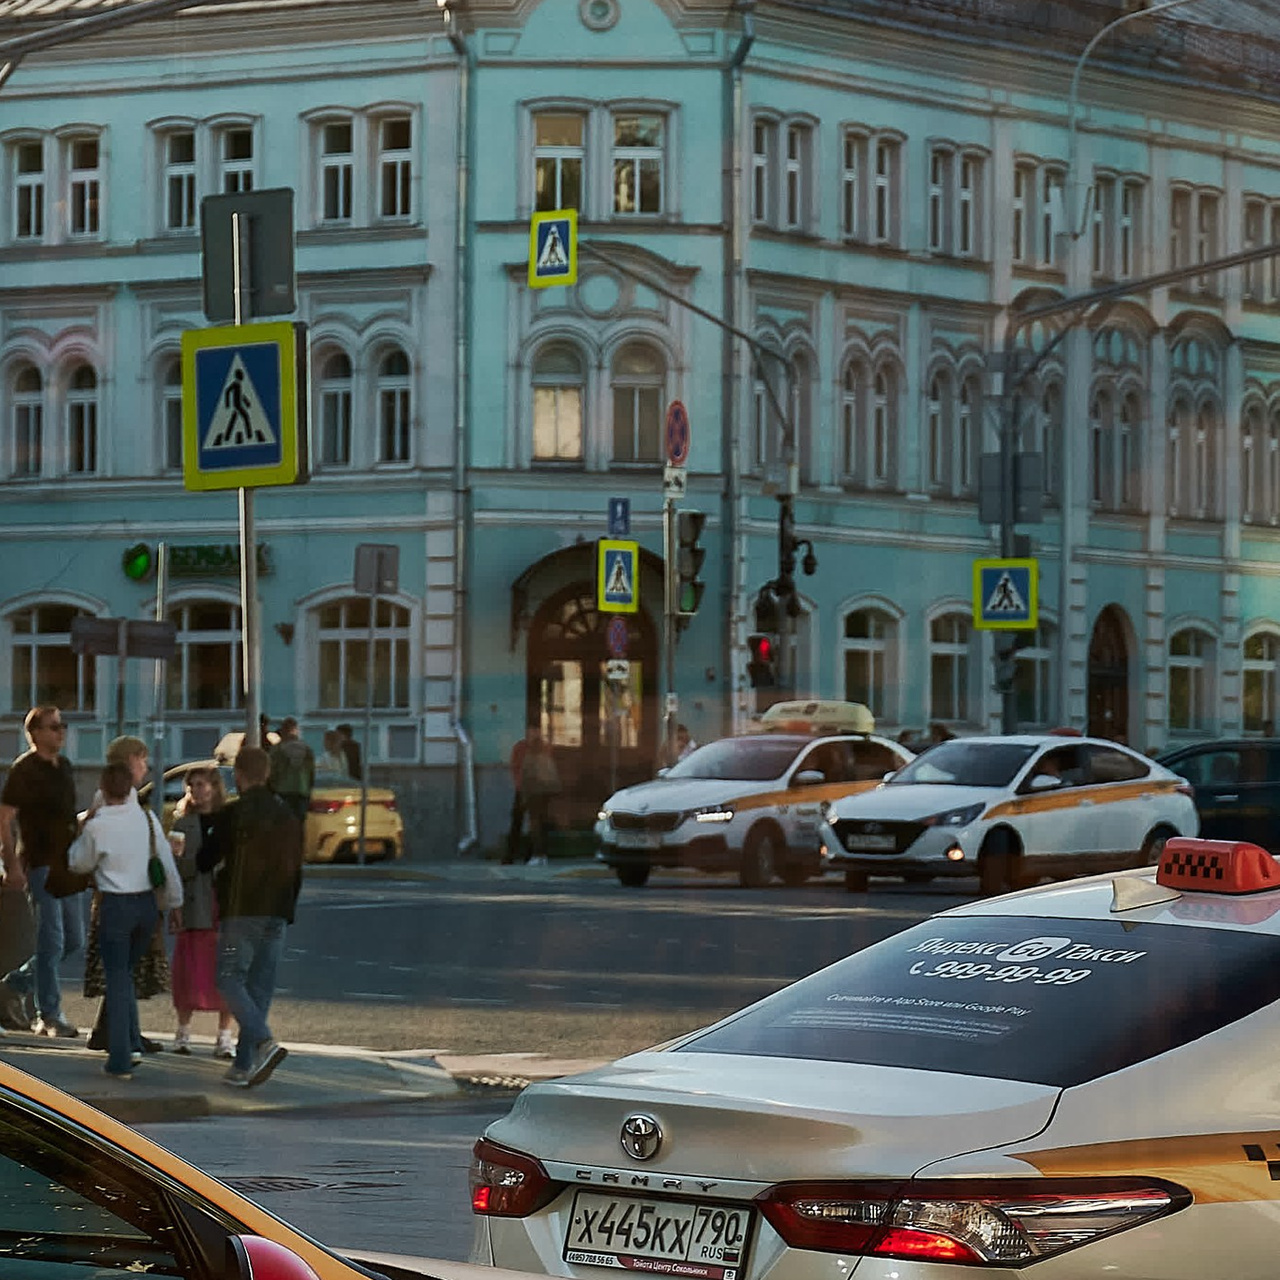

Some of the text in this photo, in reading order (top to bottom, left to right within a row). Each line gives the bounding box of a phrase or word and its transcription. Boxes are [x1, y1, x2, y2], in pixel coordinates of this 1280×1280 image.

[907, 936, 1010, 957] Яндекс
[1056, 943, 1148, 964] Такси
[923, 960, 1093, 986] 999-99-99
[891, 996, 916, 1006] App
[914, 997, 944, 1007] Store
[964, 1002, 1006, 1014] Google
[1003, 1006, 1032, 1017] Play
[575, 1170, 719, 1193] CAMRY
[695, 1207, 739, 1246] 790
[700, 1245, 724, 1261] RUS
[632, 1258, 653, 1270] Тойота
[653, 1260, 672, 1273] Центр
